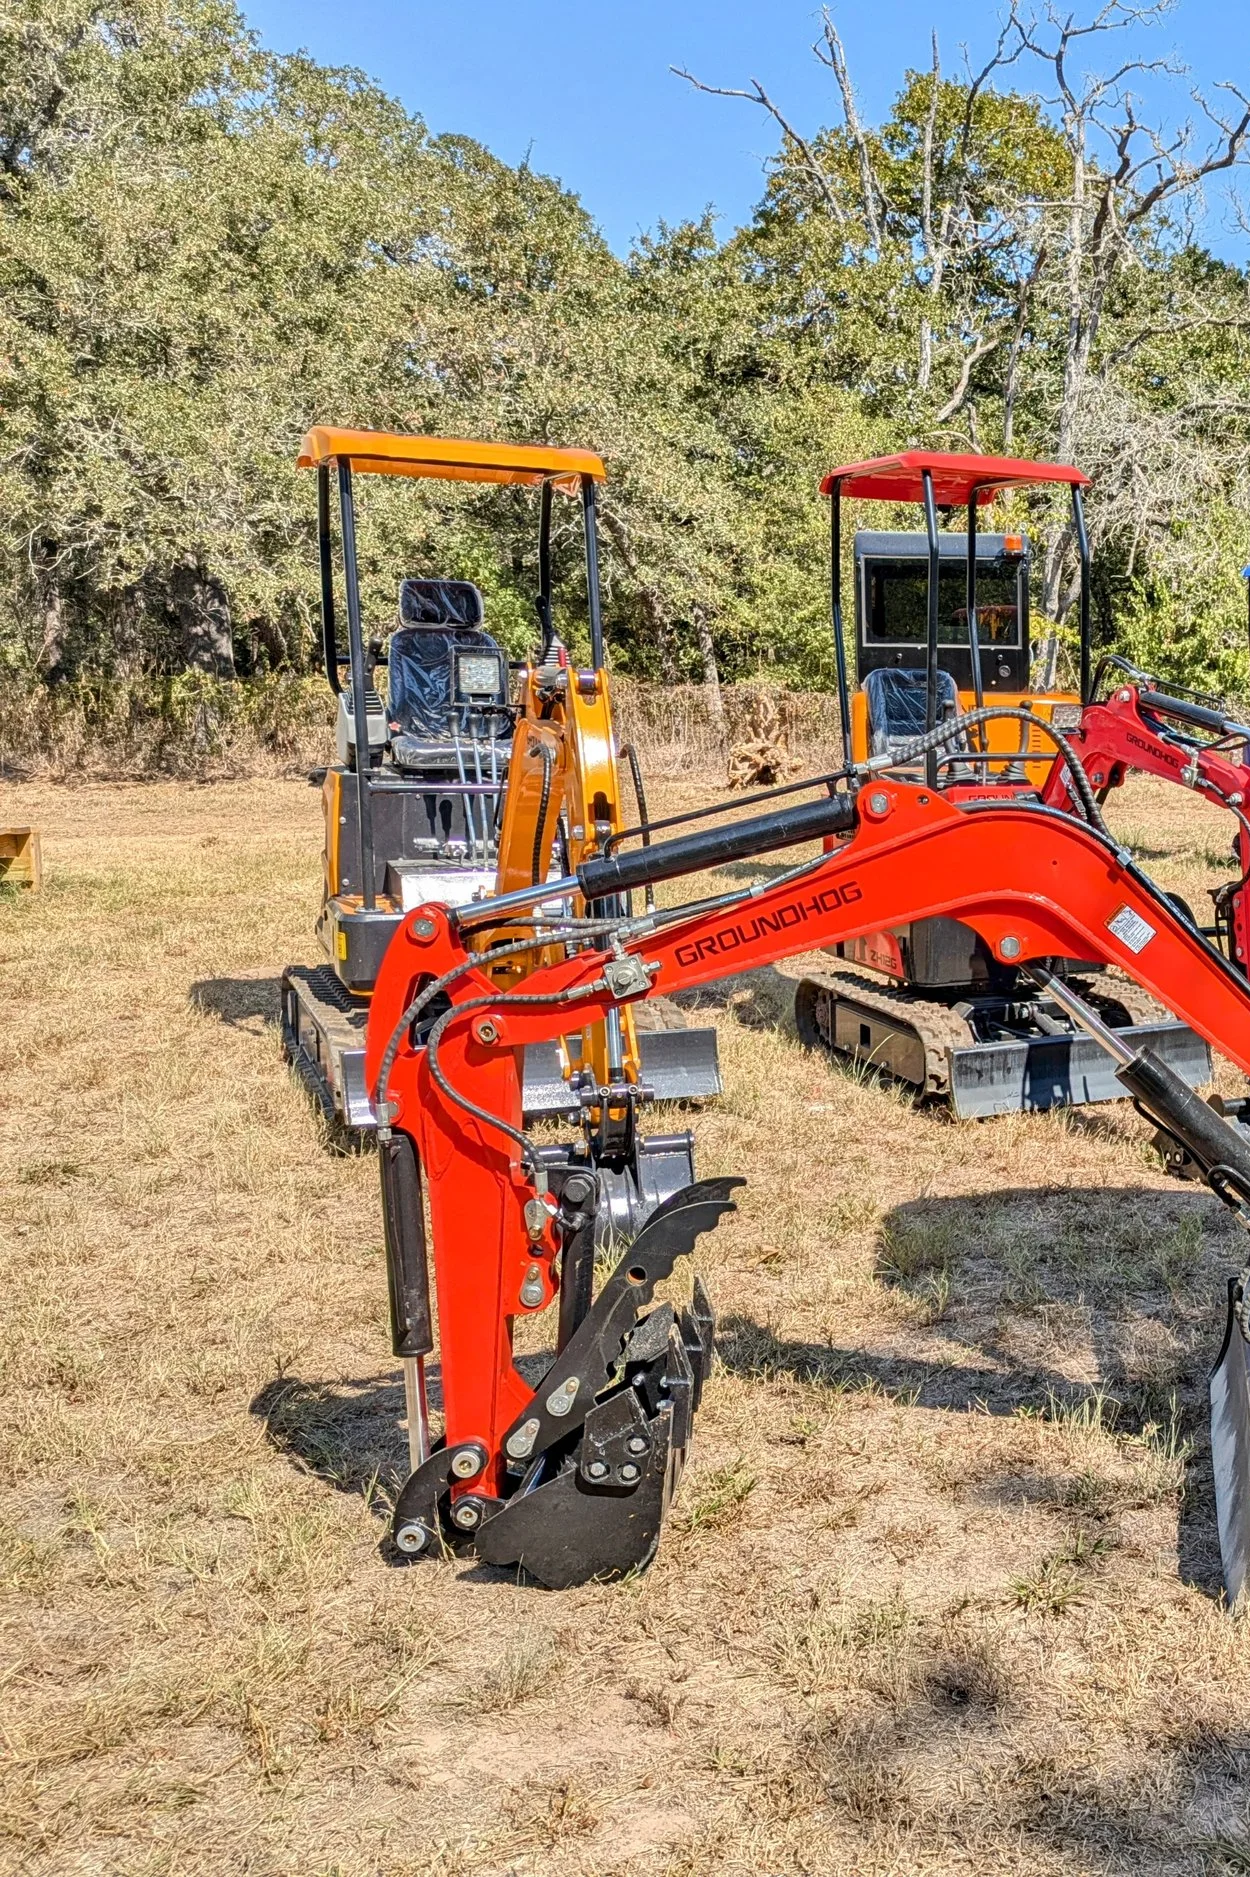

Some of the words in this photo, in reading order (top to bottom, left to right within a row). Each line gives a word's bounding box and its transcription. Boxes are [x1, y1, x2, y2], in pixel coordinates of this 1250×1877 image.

[1126, 732, 1180, 769] GROUNDHOG
[674, 881, 863, 968] GROUNDHOG
[869, 949, 897, 970] ZH12G
